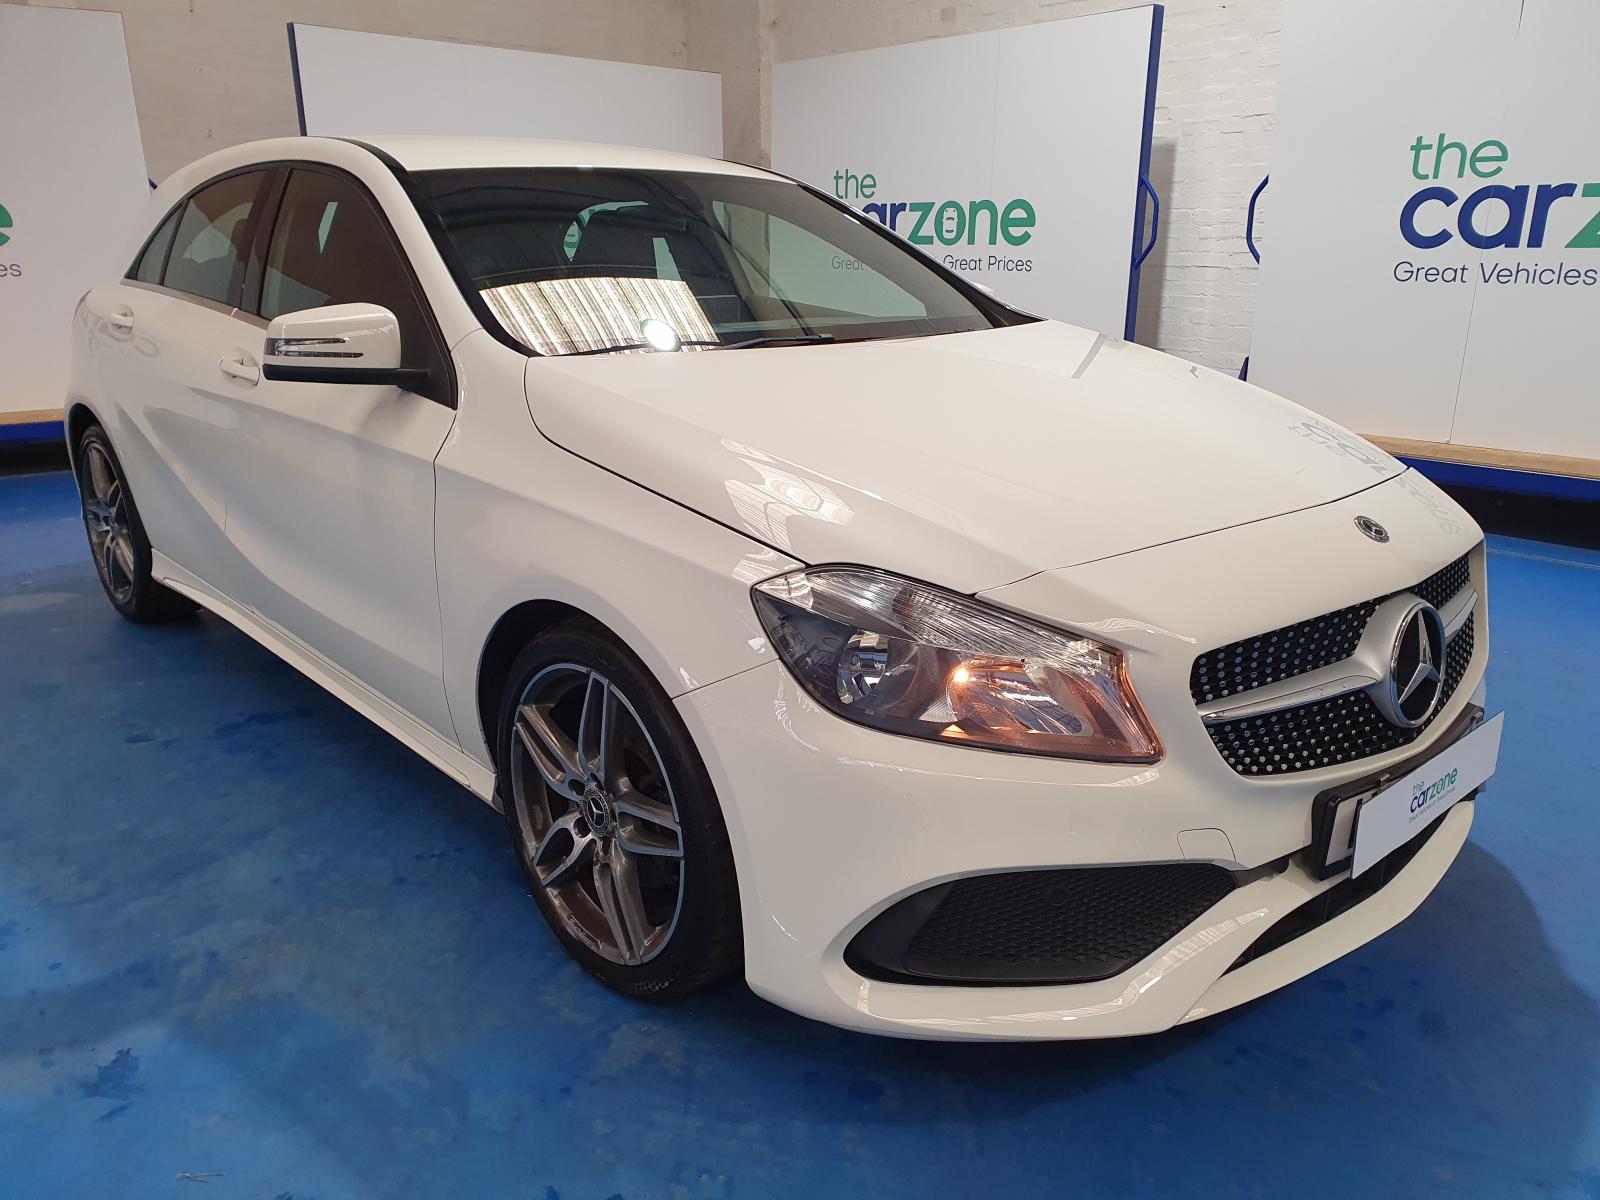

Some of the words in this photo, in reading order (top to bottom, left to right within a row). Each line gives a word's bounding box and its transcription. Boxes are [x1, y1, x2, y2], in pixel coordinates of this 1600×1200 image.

[1410, 133, 1508, 180] the
[833, 168, 877, 199] the
[862, 199, 1036, 246] arzone
[943, 255, 982, 271] Great
[988, 256, 1032, 272] Prices
[1393, 261, 1469, 283] Great
[1480, 262, 1598, 286] Vehicles
[1410, 767, 1458, 813] carzone
